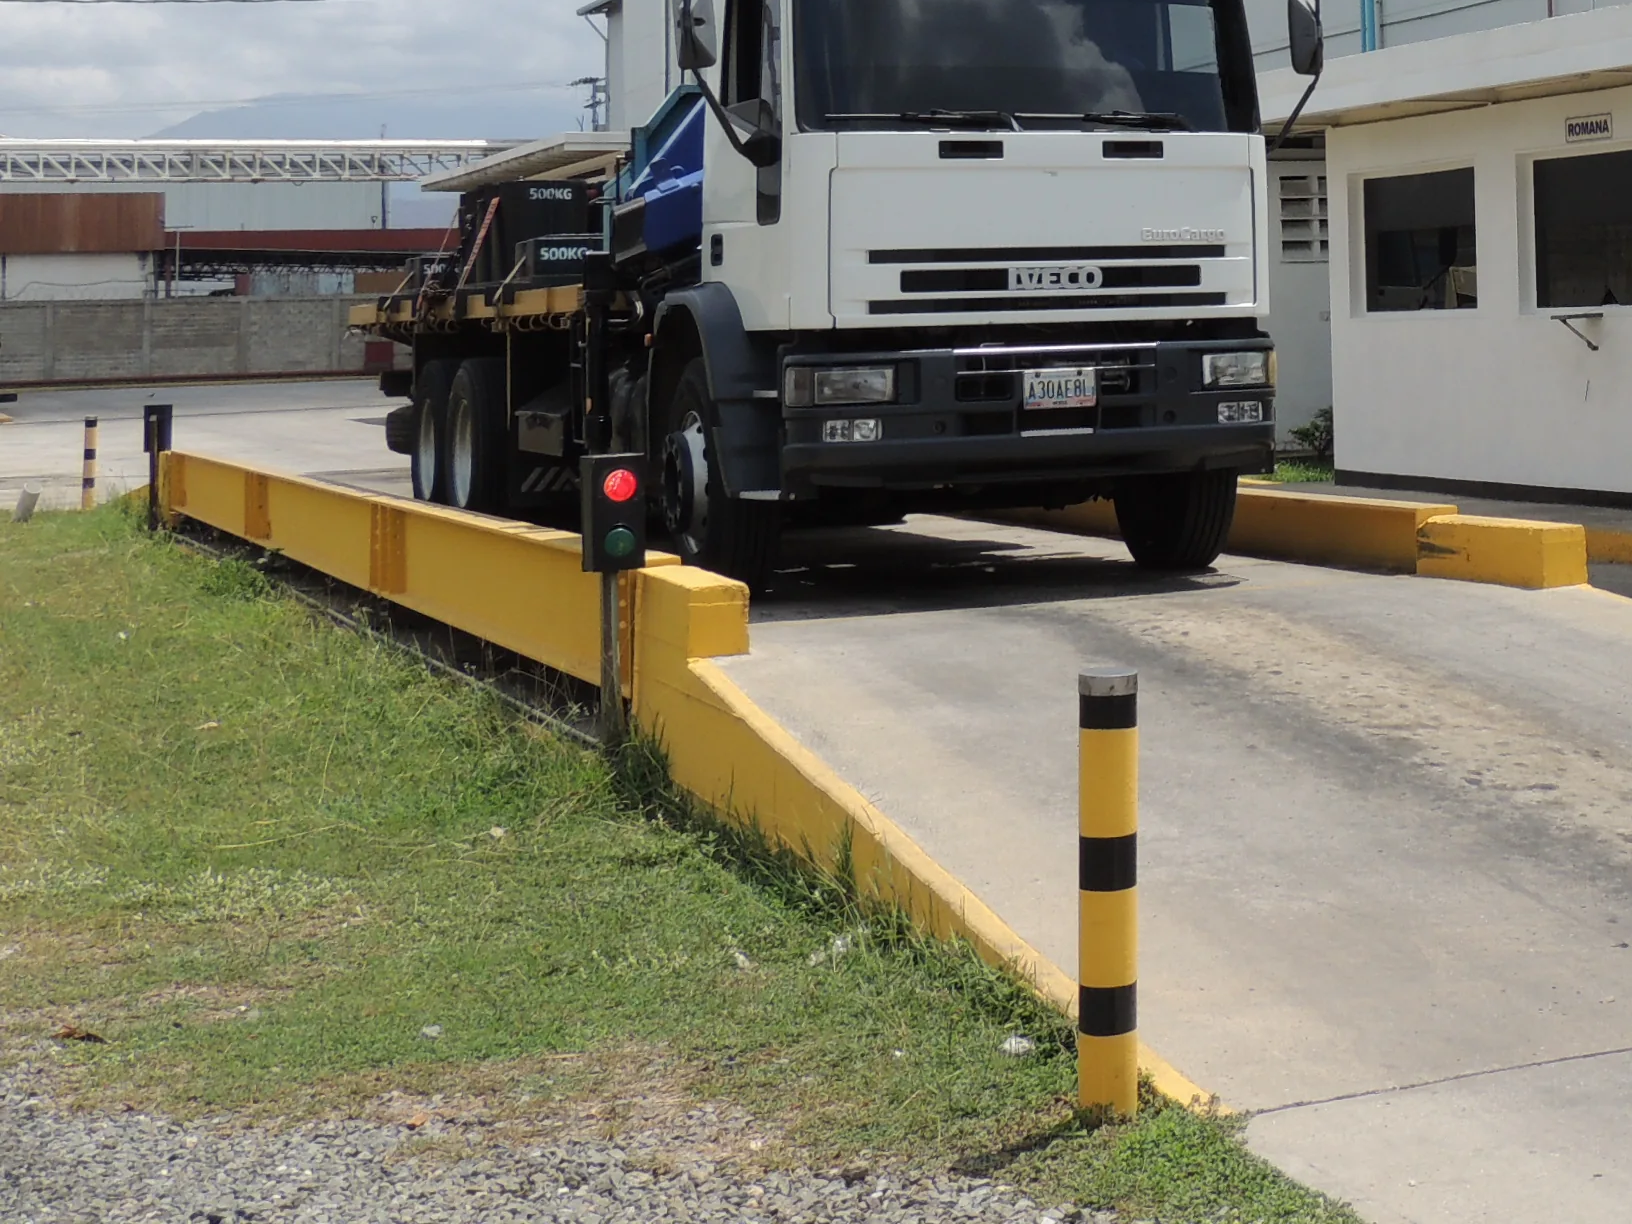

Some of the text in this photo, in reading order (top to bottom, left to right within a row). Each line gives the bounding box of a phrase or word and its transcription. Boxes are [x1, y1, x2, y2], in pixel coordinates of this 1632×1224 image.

[1567, 119, 1610, 137] ROMANA
[529, 187, 573, 200] 500KG
[1142, 226, 1226, 242] EuroCargo
[1008, 265, 1104, 290] IVECO
[1028, 378, 1091, 400] A30AE8L
